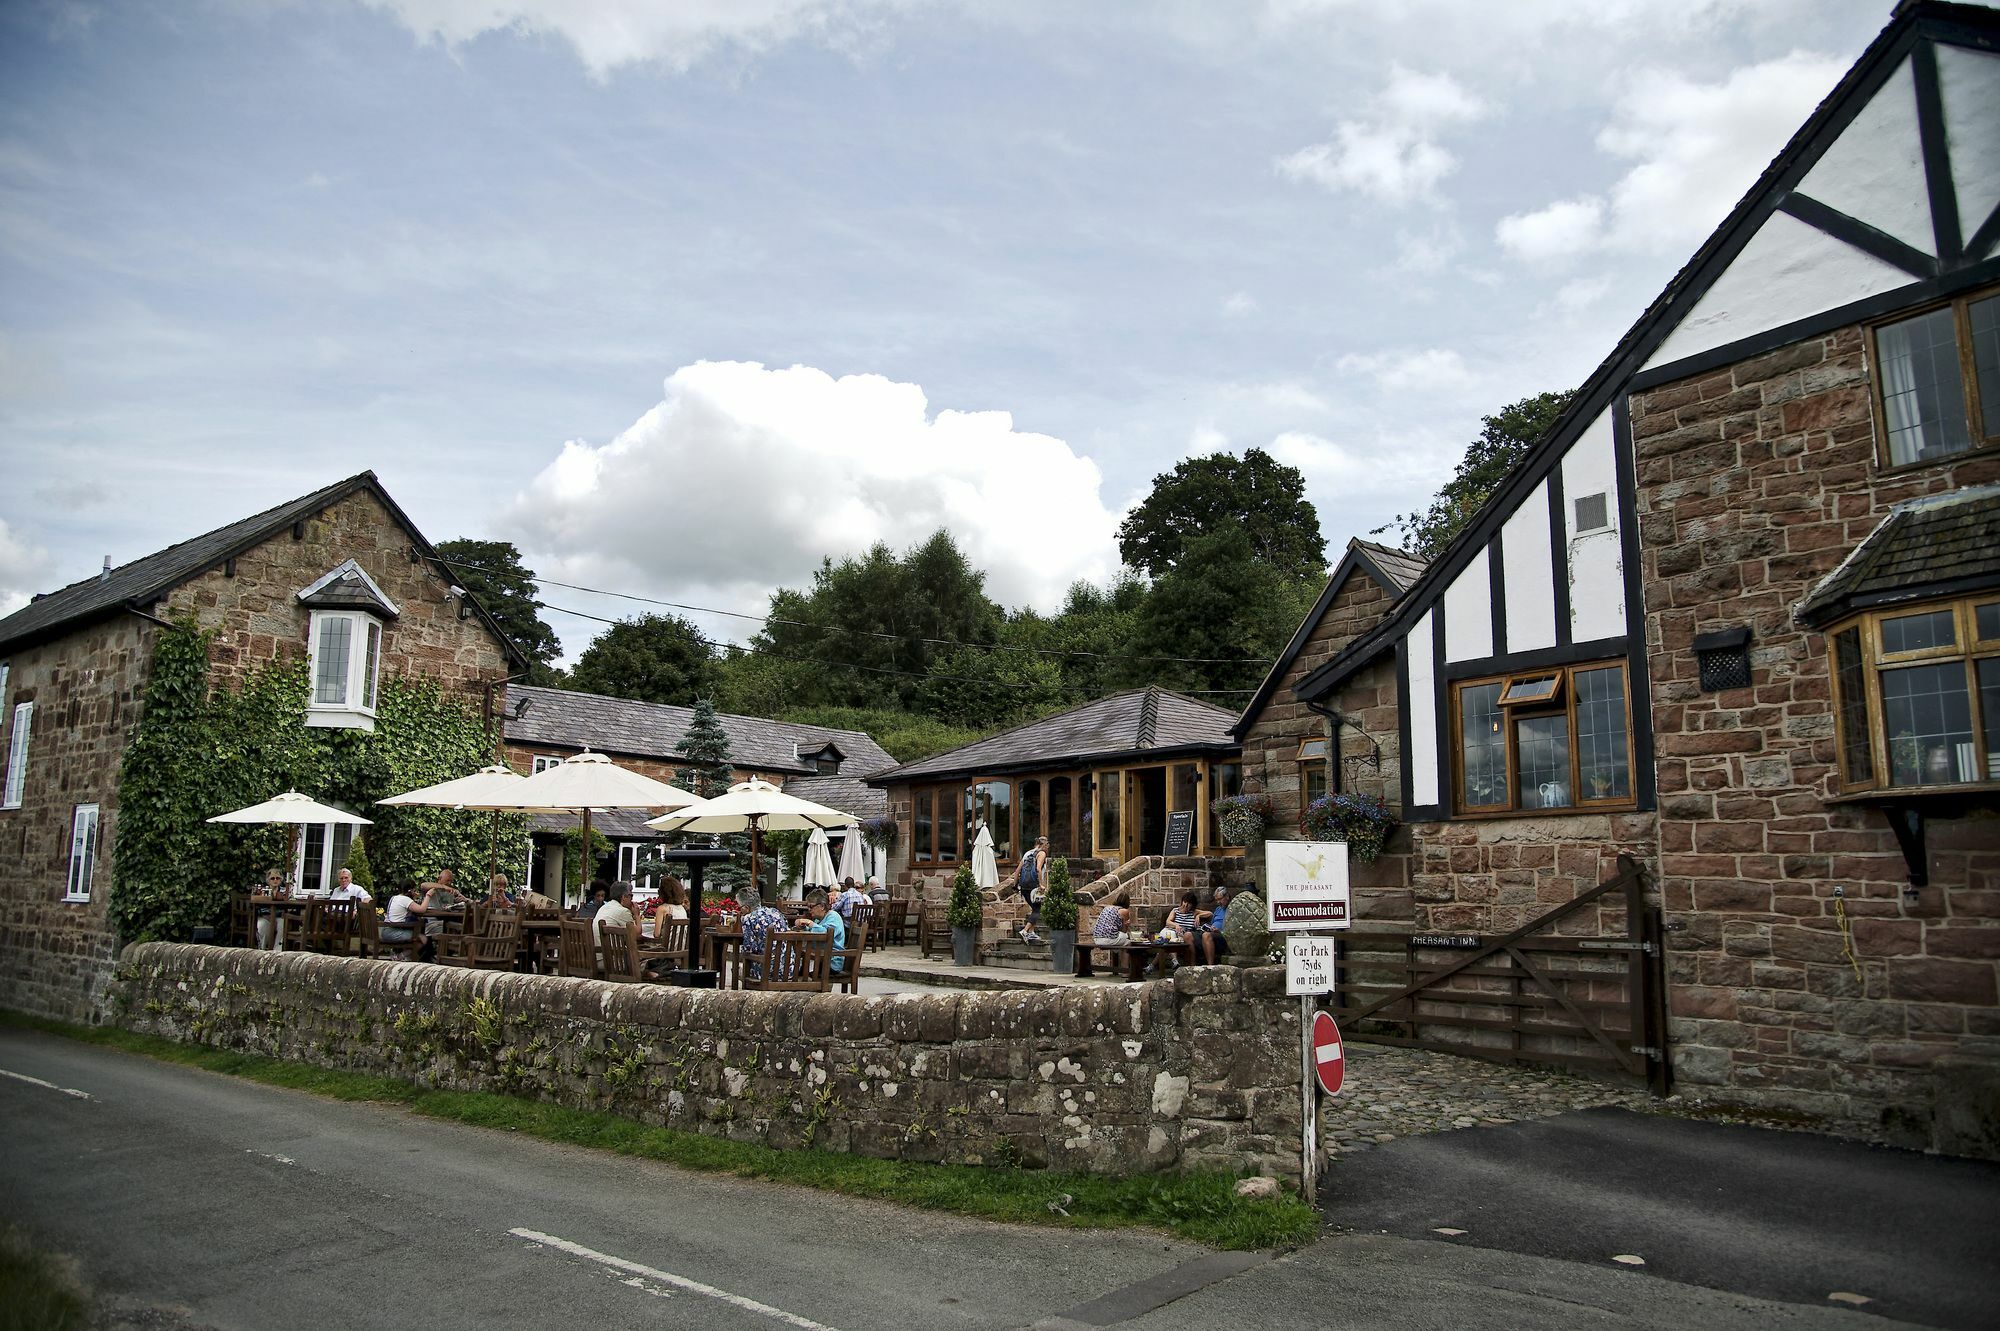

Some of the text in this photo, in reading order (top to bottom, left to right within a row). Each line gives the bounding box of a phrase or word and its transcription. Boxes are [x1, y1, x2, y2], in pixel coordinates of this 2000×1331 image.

[1276, 903, 1344, 917] Accommodation
[1412, 936, 1475, 946] PHEASANT INN
[1293, 945, 1329, 957] Car Park
[1301, 959, 1322, 972] 75yds
[1296, 973, 1327, 987] on right
